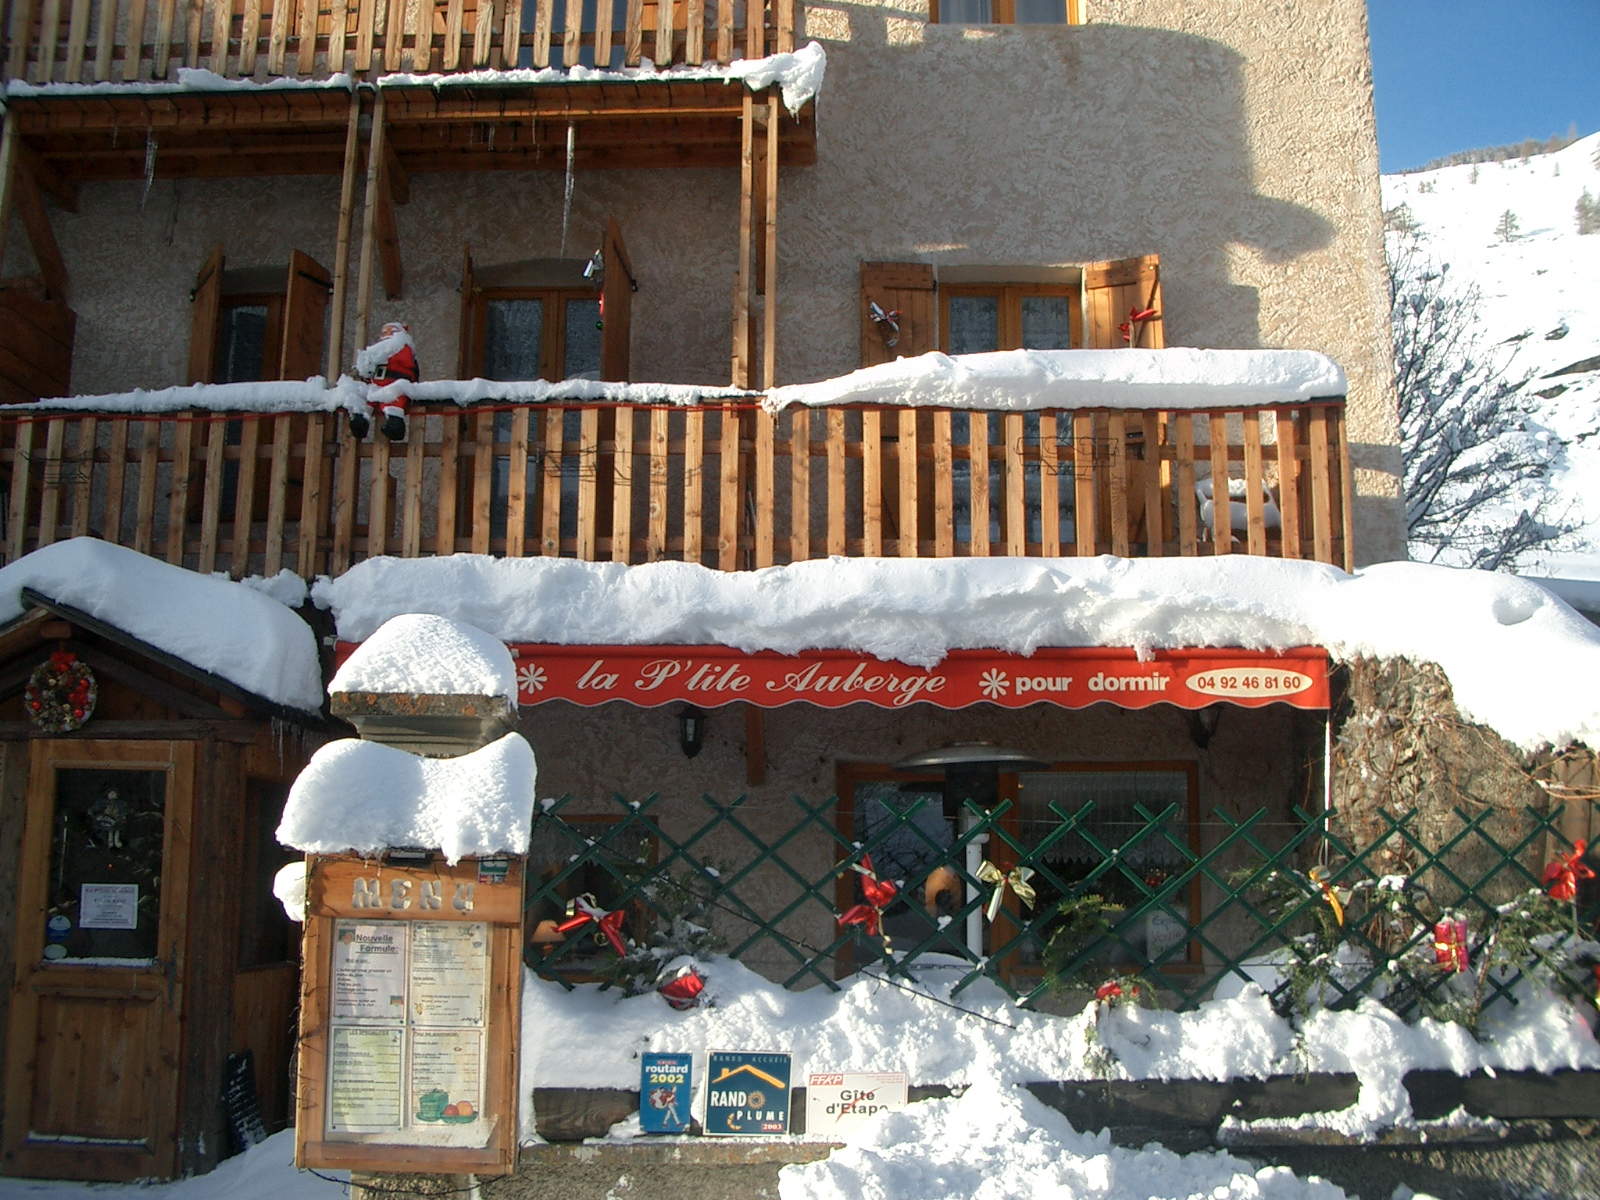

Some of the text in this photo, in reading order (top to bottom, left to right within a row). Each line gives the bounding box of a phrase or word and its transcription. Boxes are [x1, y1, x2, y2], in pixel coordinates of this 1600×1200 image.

[576, 659, 947, 706] la P'tite Auberge
[1015, 672, 1170, 695] pour dormir
[1197, 676, 1301, 689] 04 92 46 81 60
[352, 877, 475, 912] MENU
[356, 933, 394, 942] Nouvelle
[645, 1063, 689, 1074] routard
[650, 1073, 684, 1084] 2002
[840, 1090, 875, 1101] Gîte
[736, 1110, 785, 1121] PLUME
